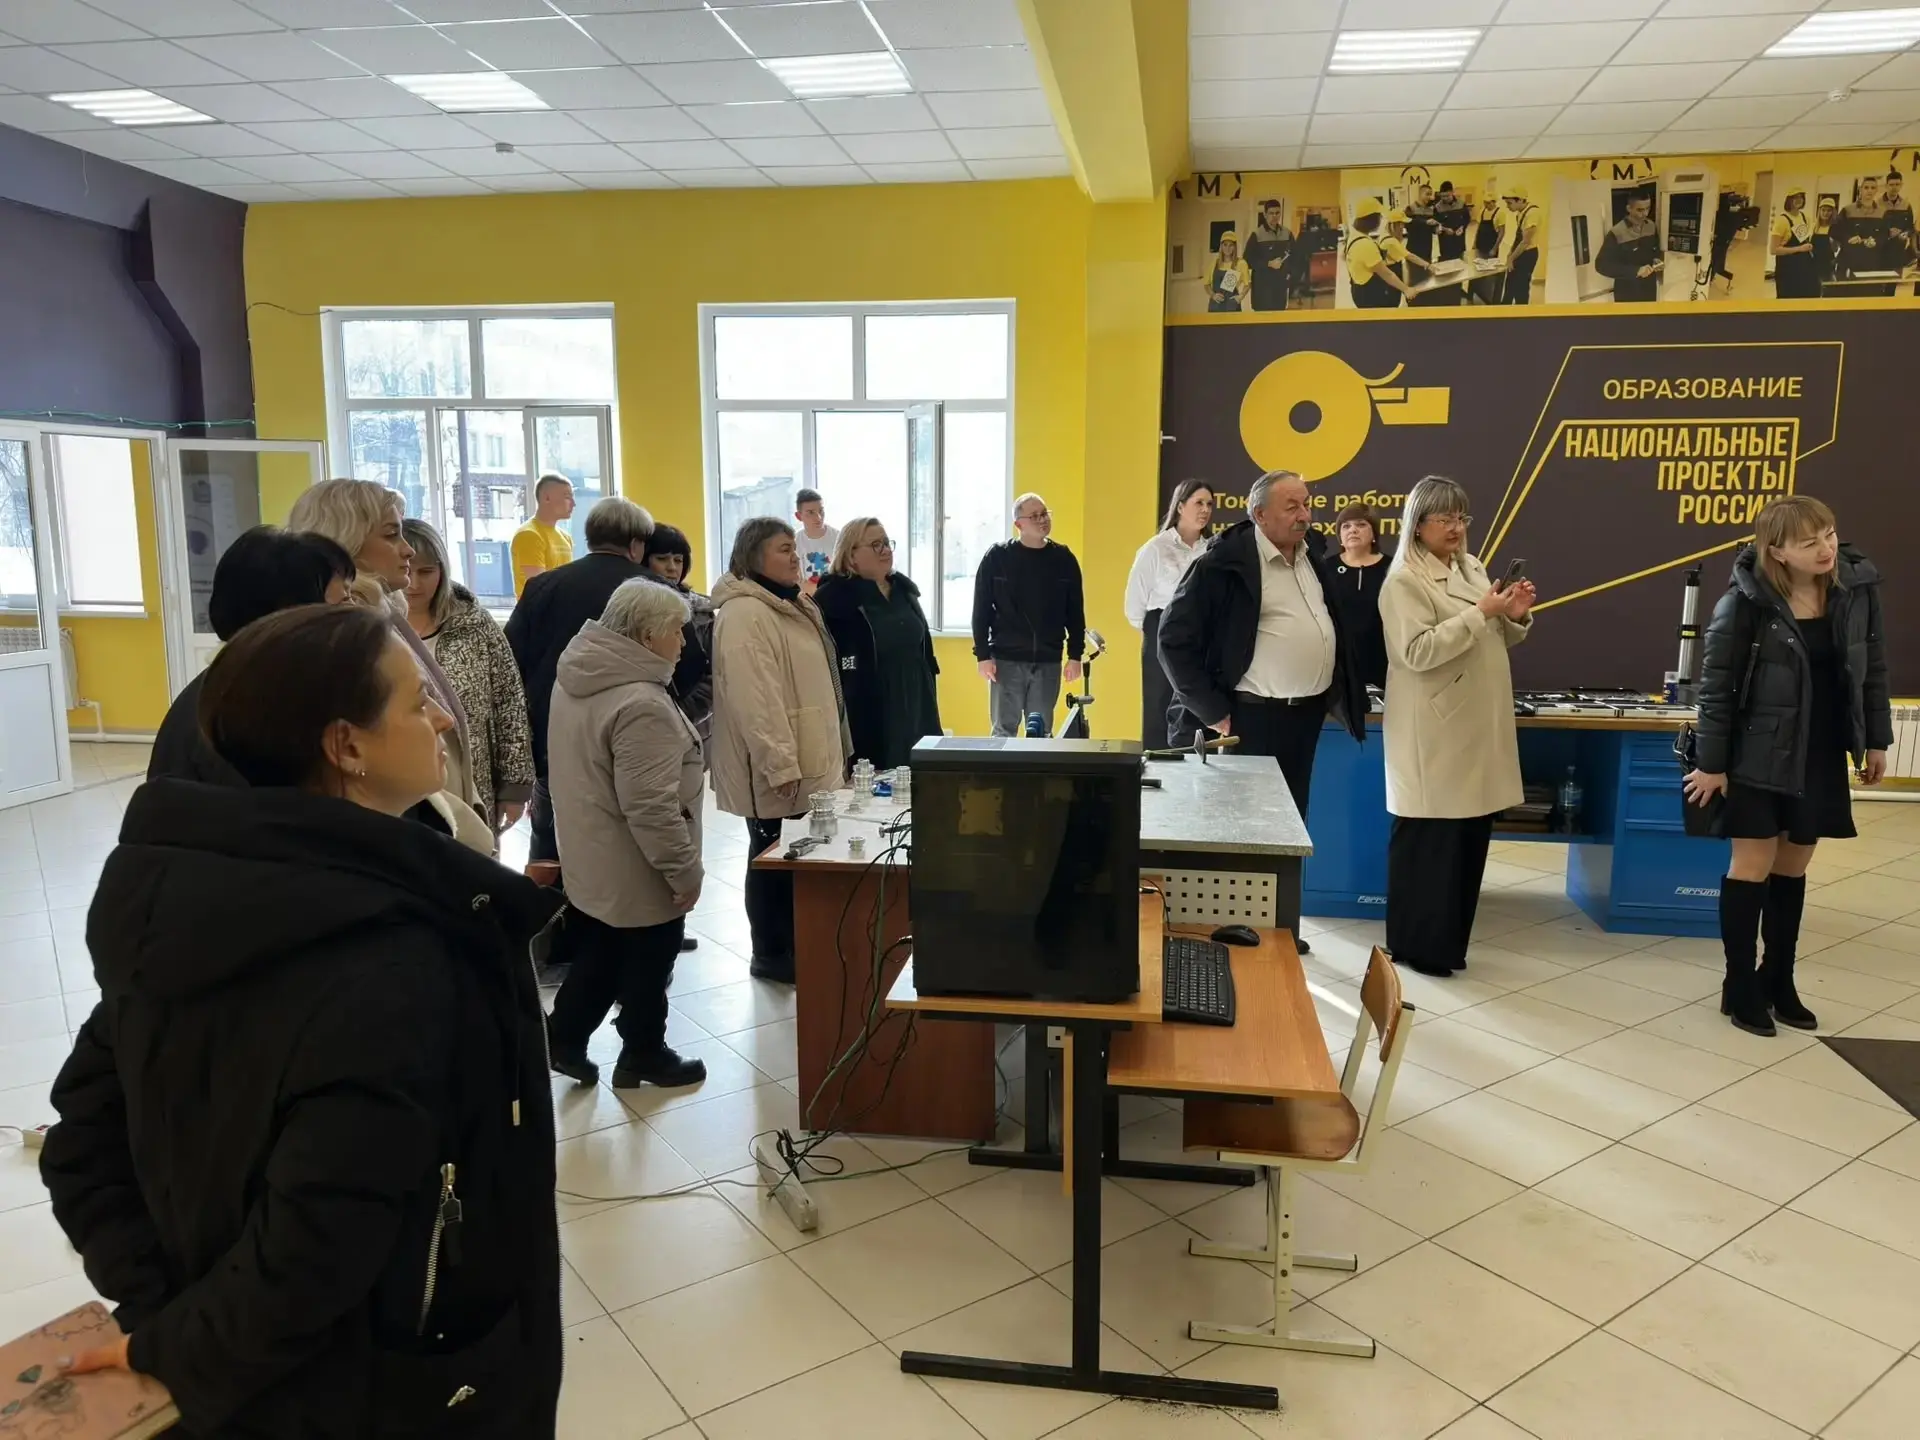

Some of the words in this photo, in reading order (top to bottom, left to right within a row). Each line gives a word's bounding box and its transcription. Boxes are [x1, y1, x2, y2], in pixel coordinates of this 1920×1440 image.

[1603, 377, 1803, 400] ОБРАЗОВАНИЕ
[1565, 426, 1790, 460] НАЦИОНАЛЬНЫЕ
[1657, 460, 1787, 490] ПРОЕКТЫ
[1334, 490, 1409, 512] работ
[1678, 494, 1784, 524] РОССИ
